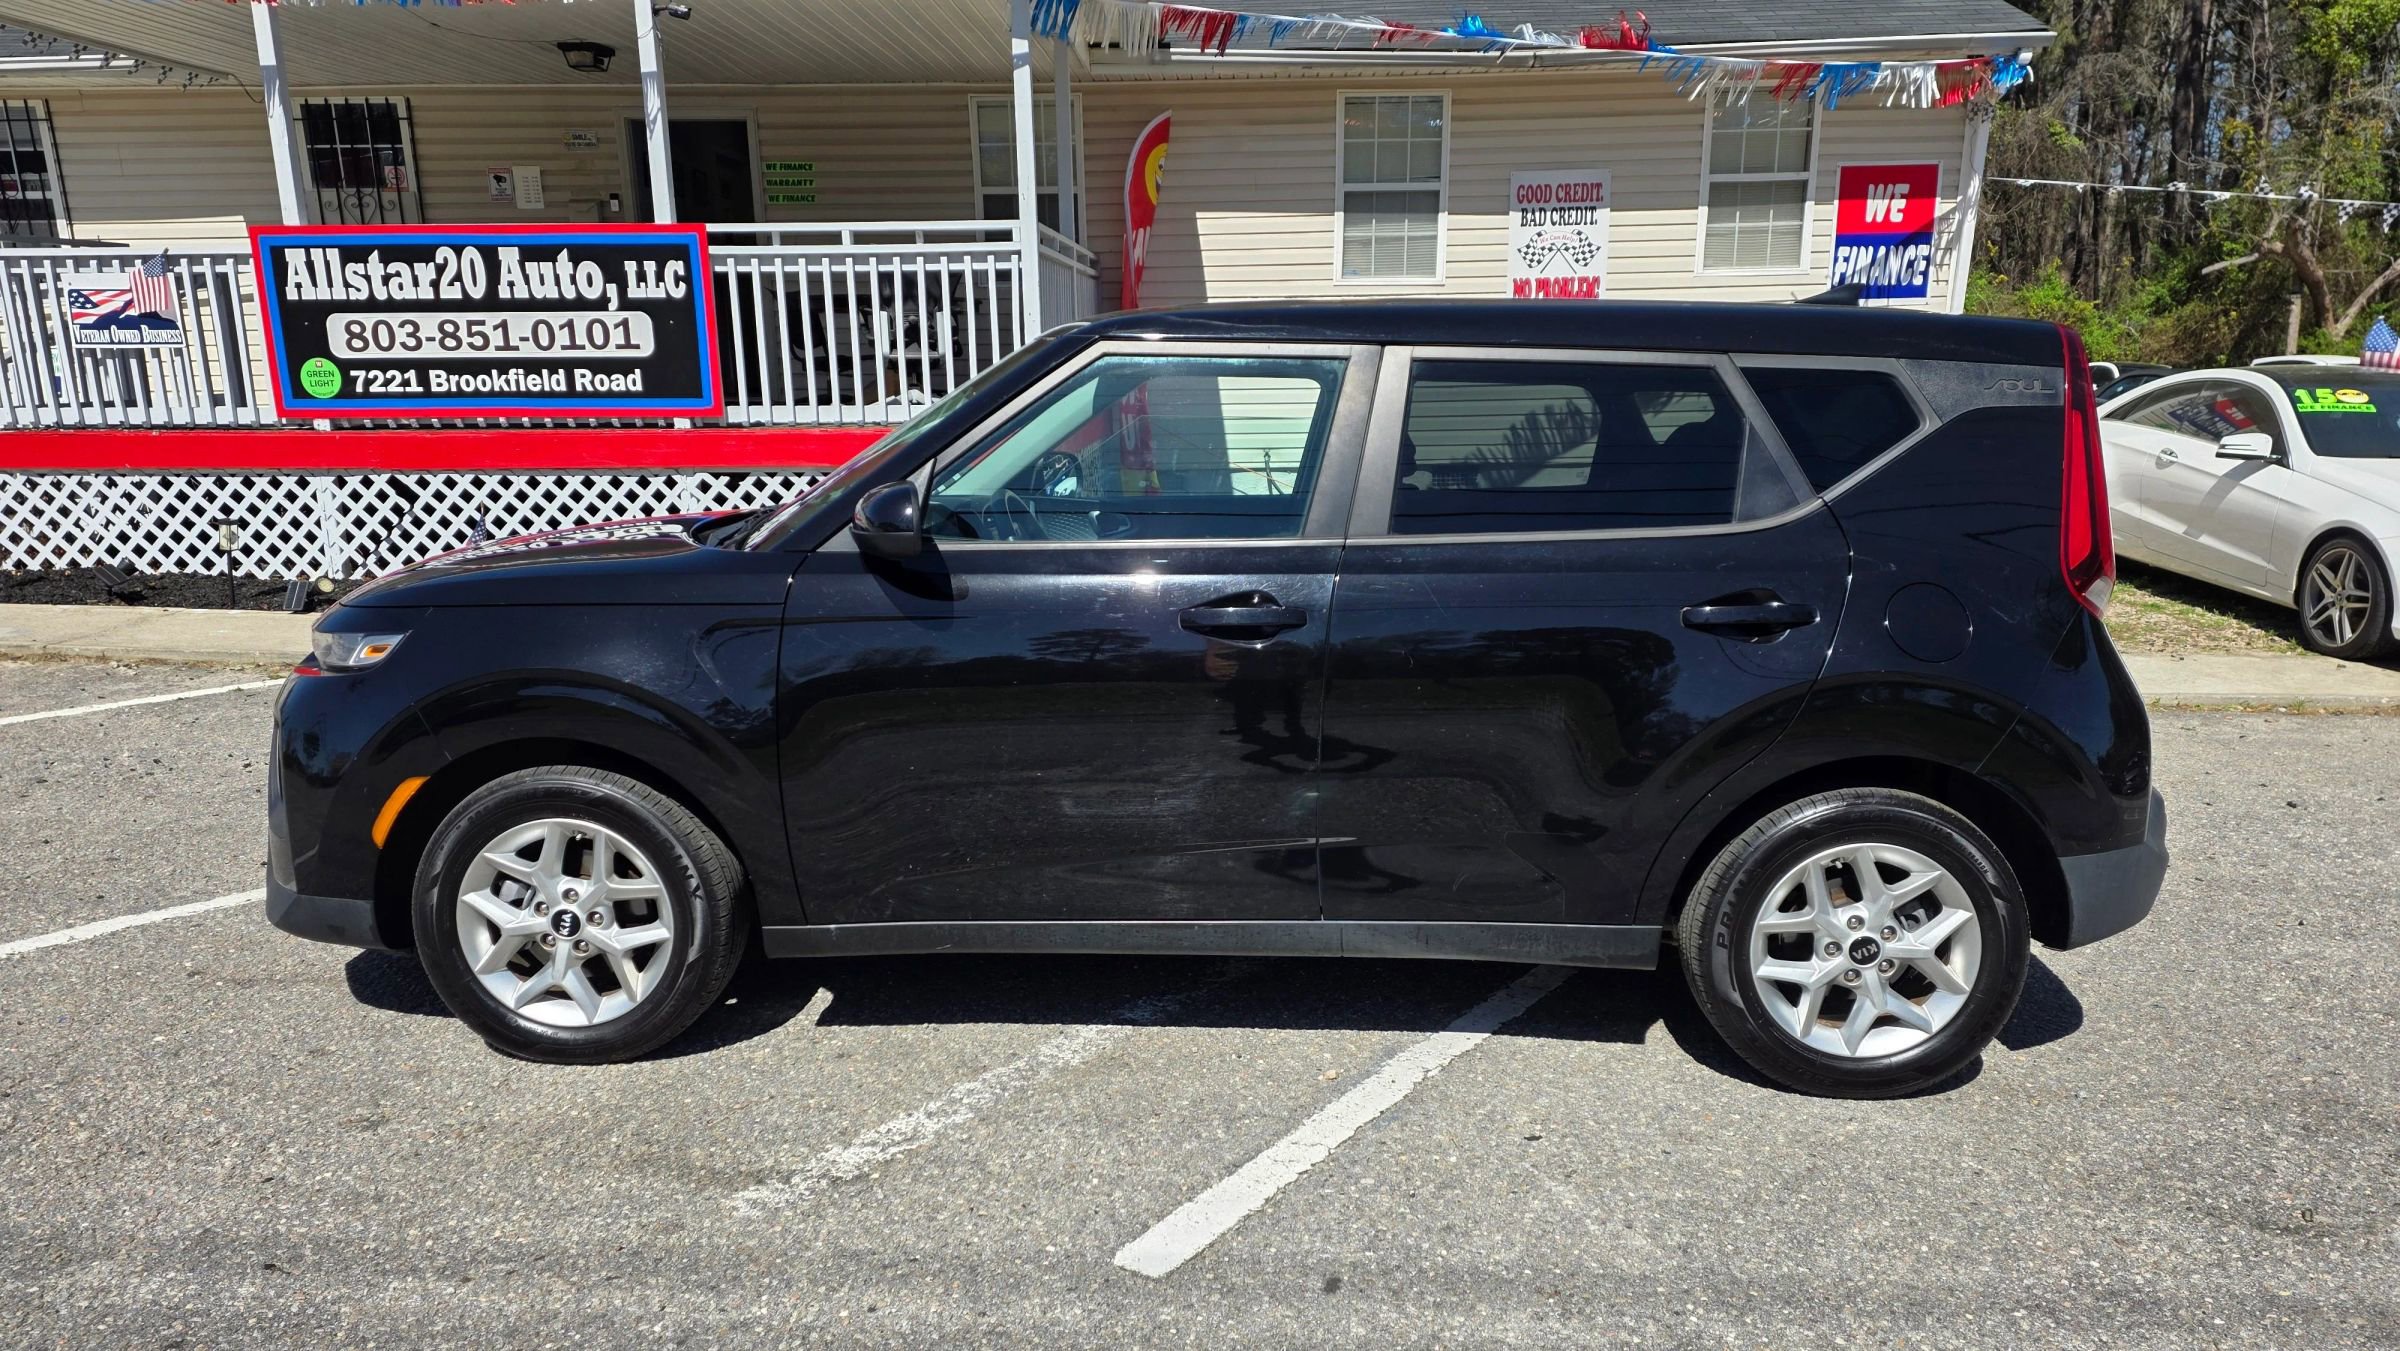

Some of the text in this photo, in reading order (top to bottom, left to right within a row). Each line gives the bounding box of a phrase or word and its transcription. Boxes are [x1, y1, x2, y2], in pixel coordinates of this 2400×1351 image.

[765, 163, 813, 171] WE FINANCE
[766, 179, 815, 187] WARRANTY
[1516, 182, 1604, 204] GOOD CREDIT.
[768, 194, 817, 202] WE FINANCE
[1865, 183, 1911, 223] WE
[1520, 206, 1598, 227] BAD CREDIT.
[1832, 244, 1931, 287] FINANCE
[284, 245, 687, 311] Allstar20 Auto, LLC
[1512, 276, 1601, 298] NO PROBLEM!
[72, 324, 182, 343] VETERAN OWNED BUSINESS
[343, 316, 641, 353] 803-851-0101
[306, 370, 335, 378] GREEN
[309, 379, 335, 388] LIGHT
[349, 368, 643, 394] 7221 Brookfield Road
[2294, 388, 2338, 404] 15
[558, 912, 574, 936] KIA
[1851, 943, 1878, 960] KIA
